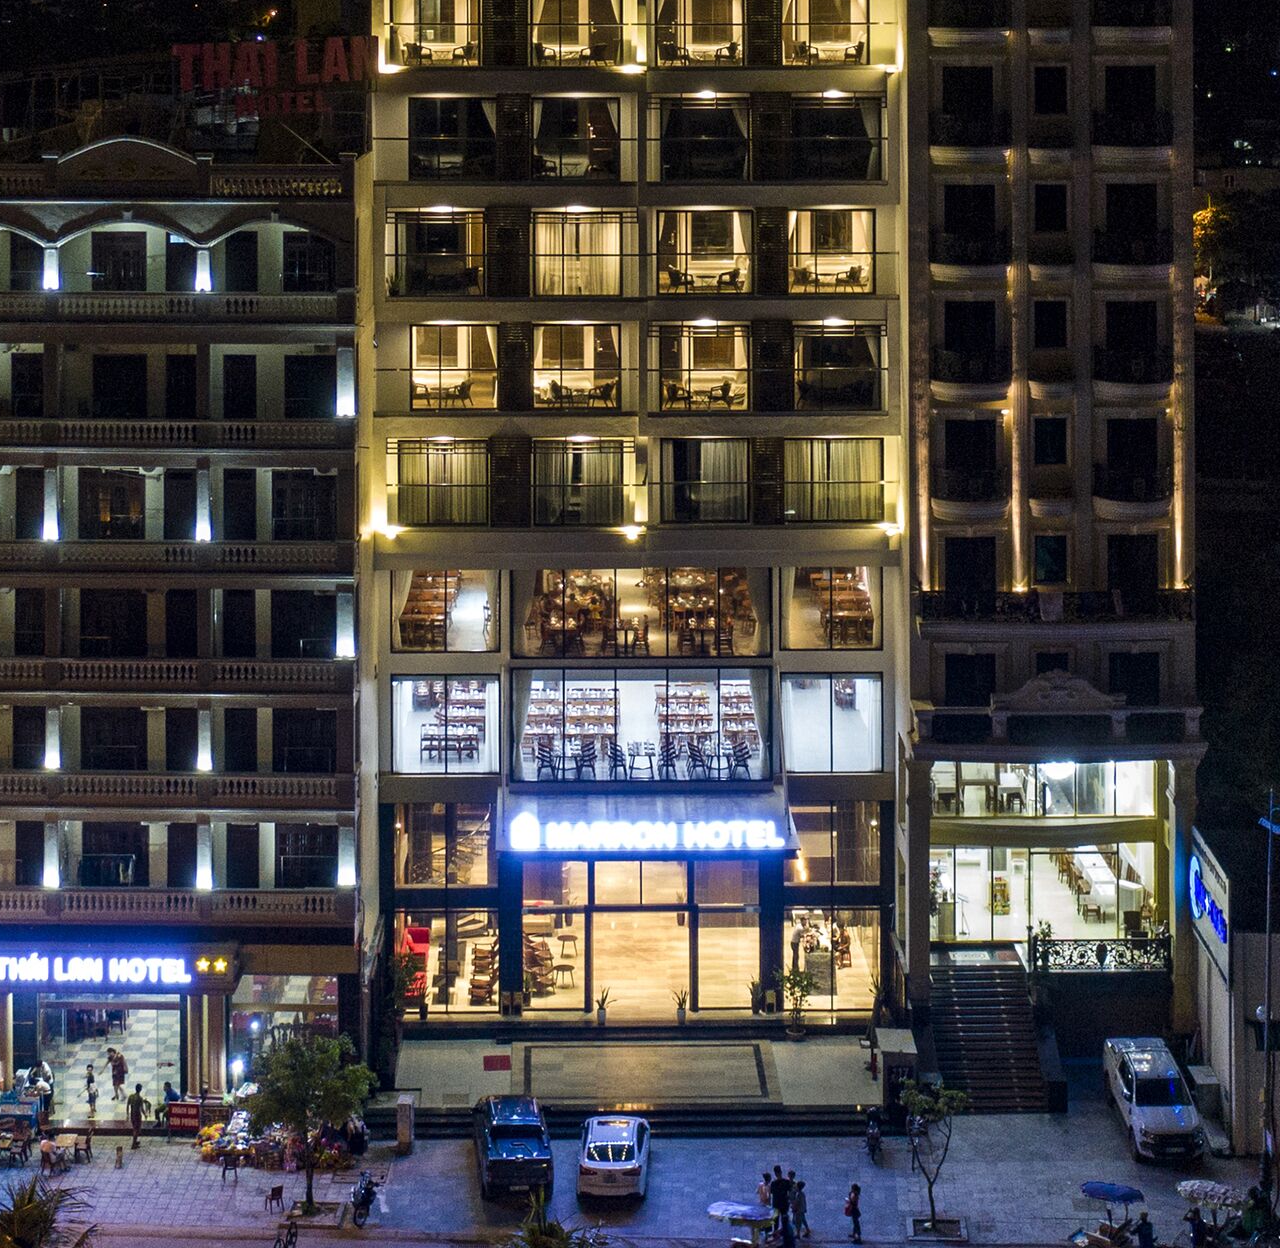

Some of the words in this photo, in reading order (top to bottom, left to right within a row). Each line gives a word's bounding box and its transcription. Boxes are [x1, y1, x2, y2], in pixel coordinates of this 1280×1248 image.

[682, 819, 786, 850] HOTEL
[53, 955, 104, 983] LAN
[108, 955, 192, 984] HOTEL
